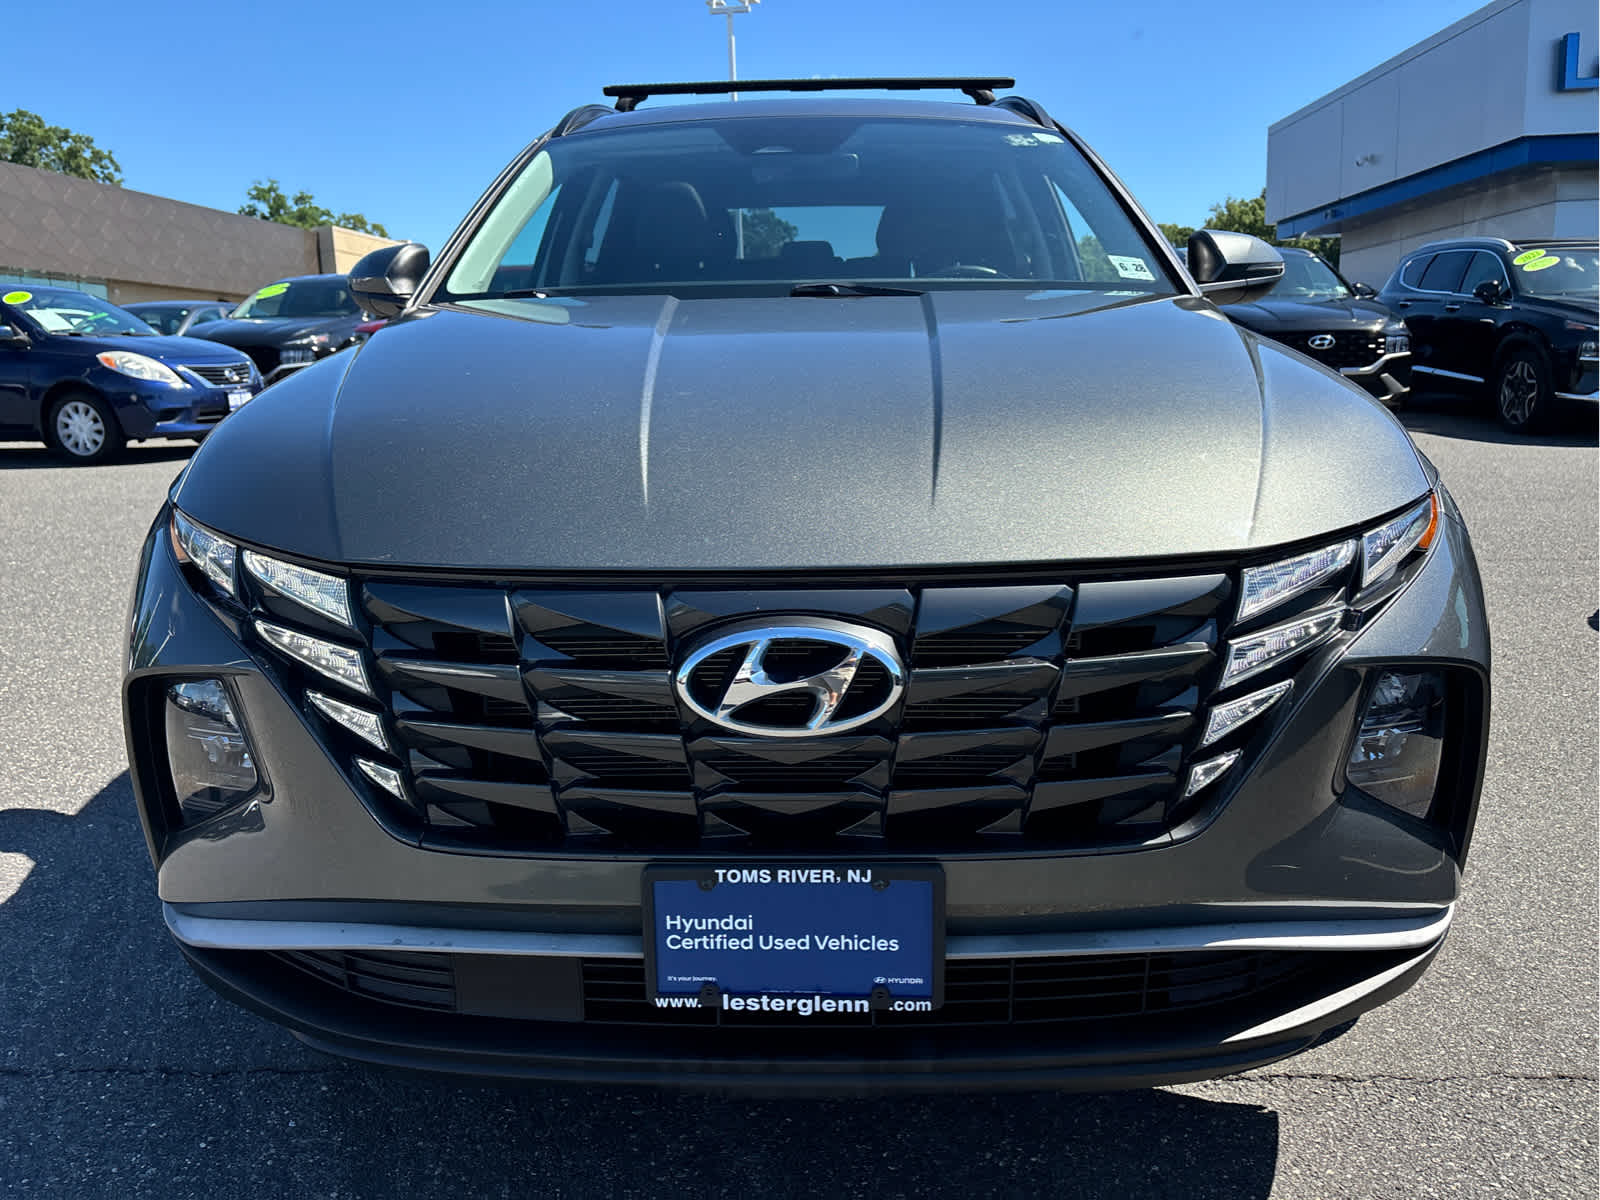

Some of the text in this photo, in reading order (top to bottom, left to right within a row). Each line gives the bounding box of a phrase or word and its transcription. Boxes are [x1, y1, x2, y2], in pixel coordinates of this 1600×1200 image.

[715, 869, 872, 885] TOMS RIVER, NJ
[666, 915, 753, 933] Hyundai
[666, 934, 900, 951] Certified Used Vehicles
[655, 994, 932, 1016] www. lesterglenn .com
